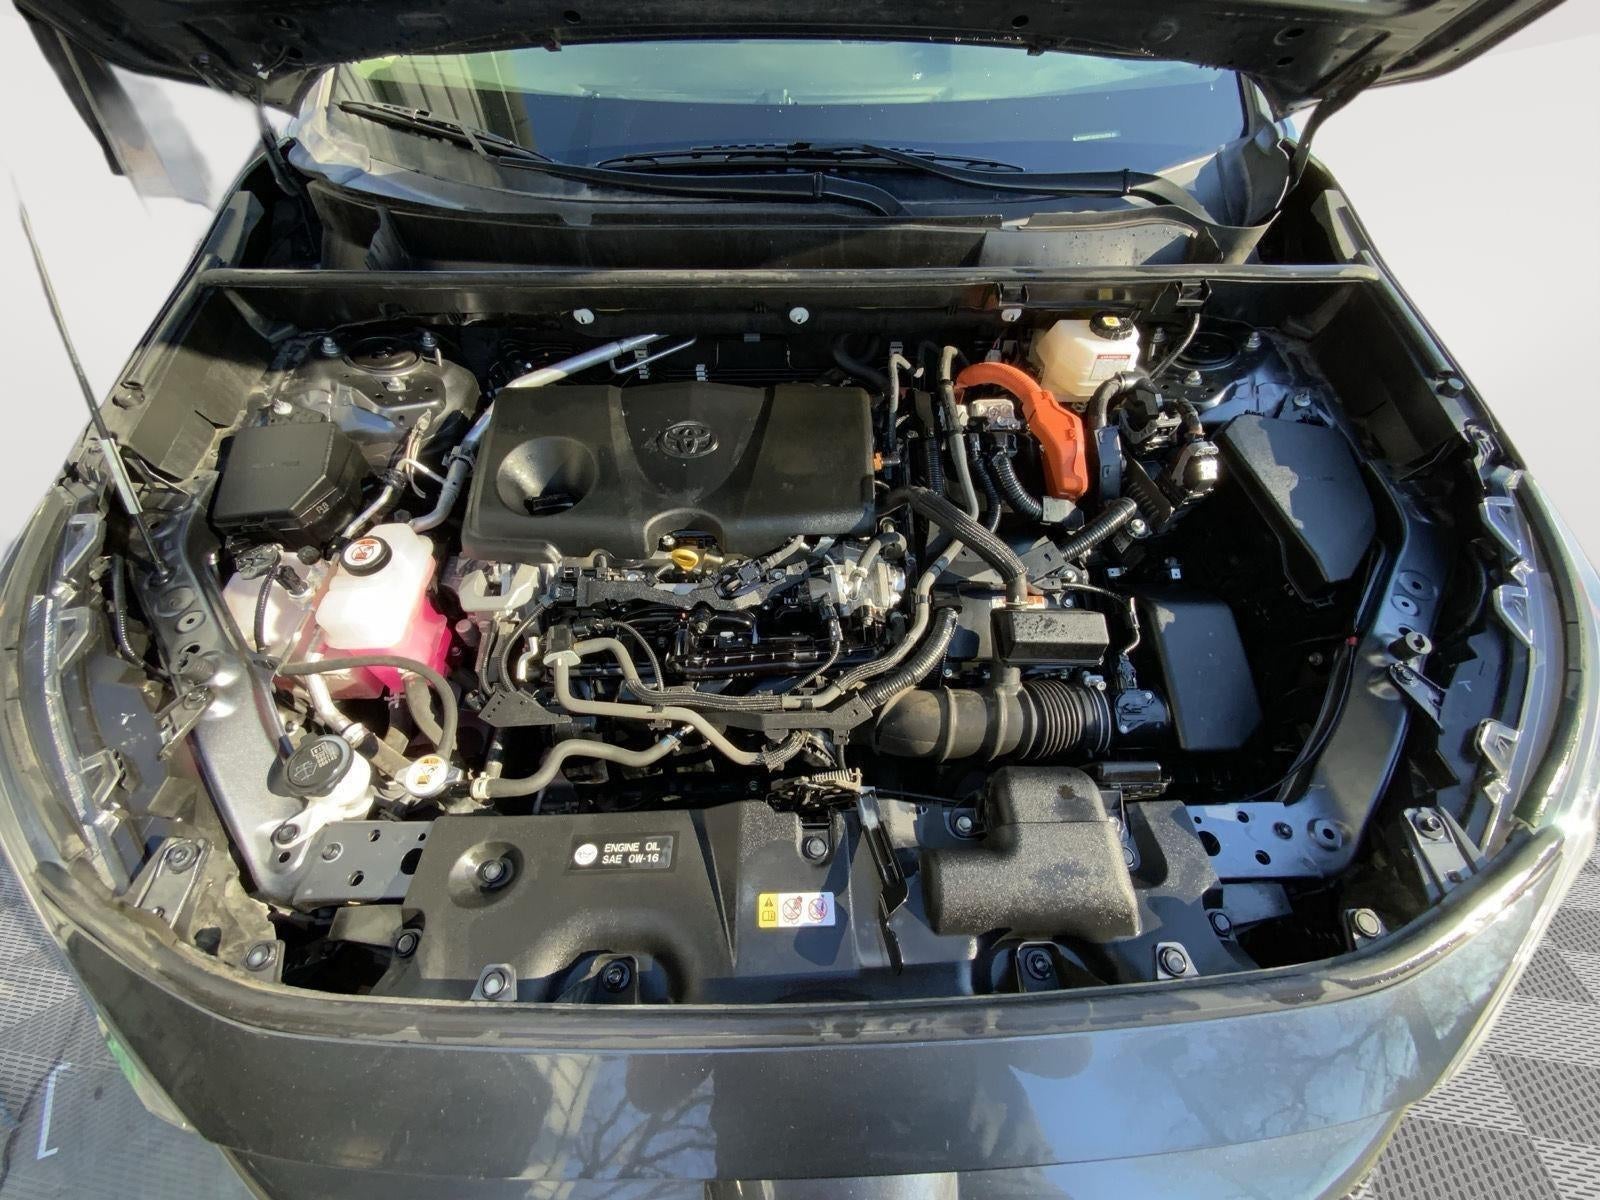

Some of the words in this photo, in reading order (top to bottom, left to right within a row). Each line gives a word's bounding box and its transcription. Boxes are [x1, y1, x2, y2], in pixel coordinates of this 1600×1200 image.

[604, 842, 640, 853] ENGINE
[645, 841, 661, 852] OIL
[601, 854, 623, 865] SAE
[628, 853, 659, 864] 0W-16
